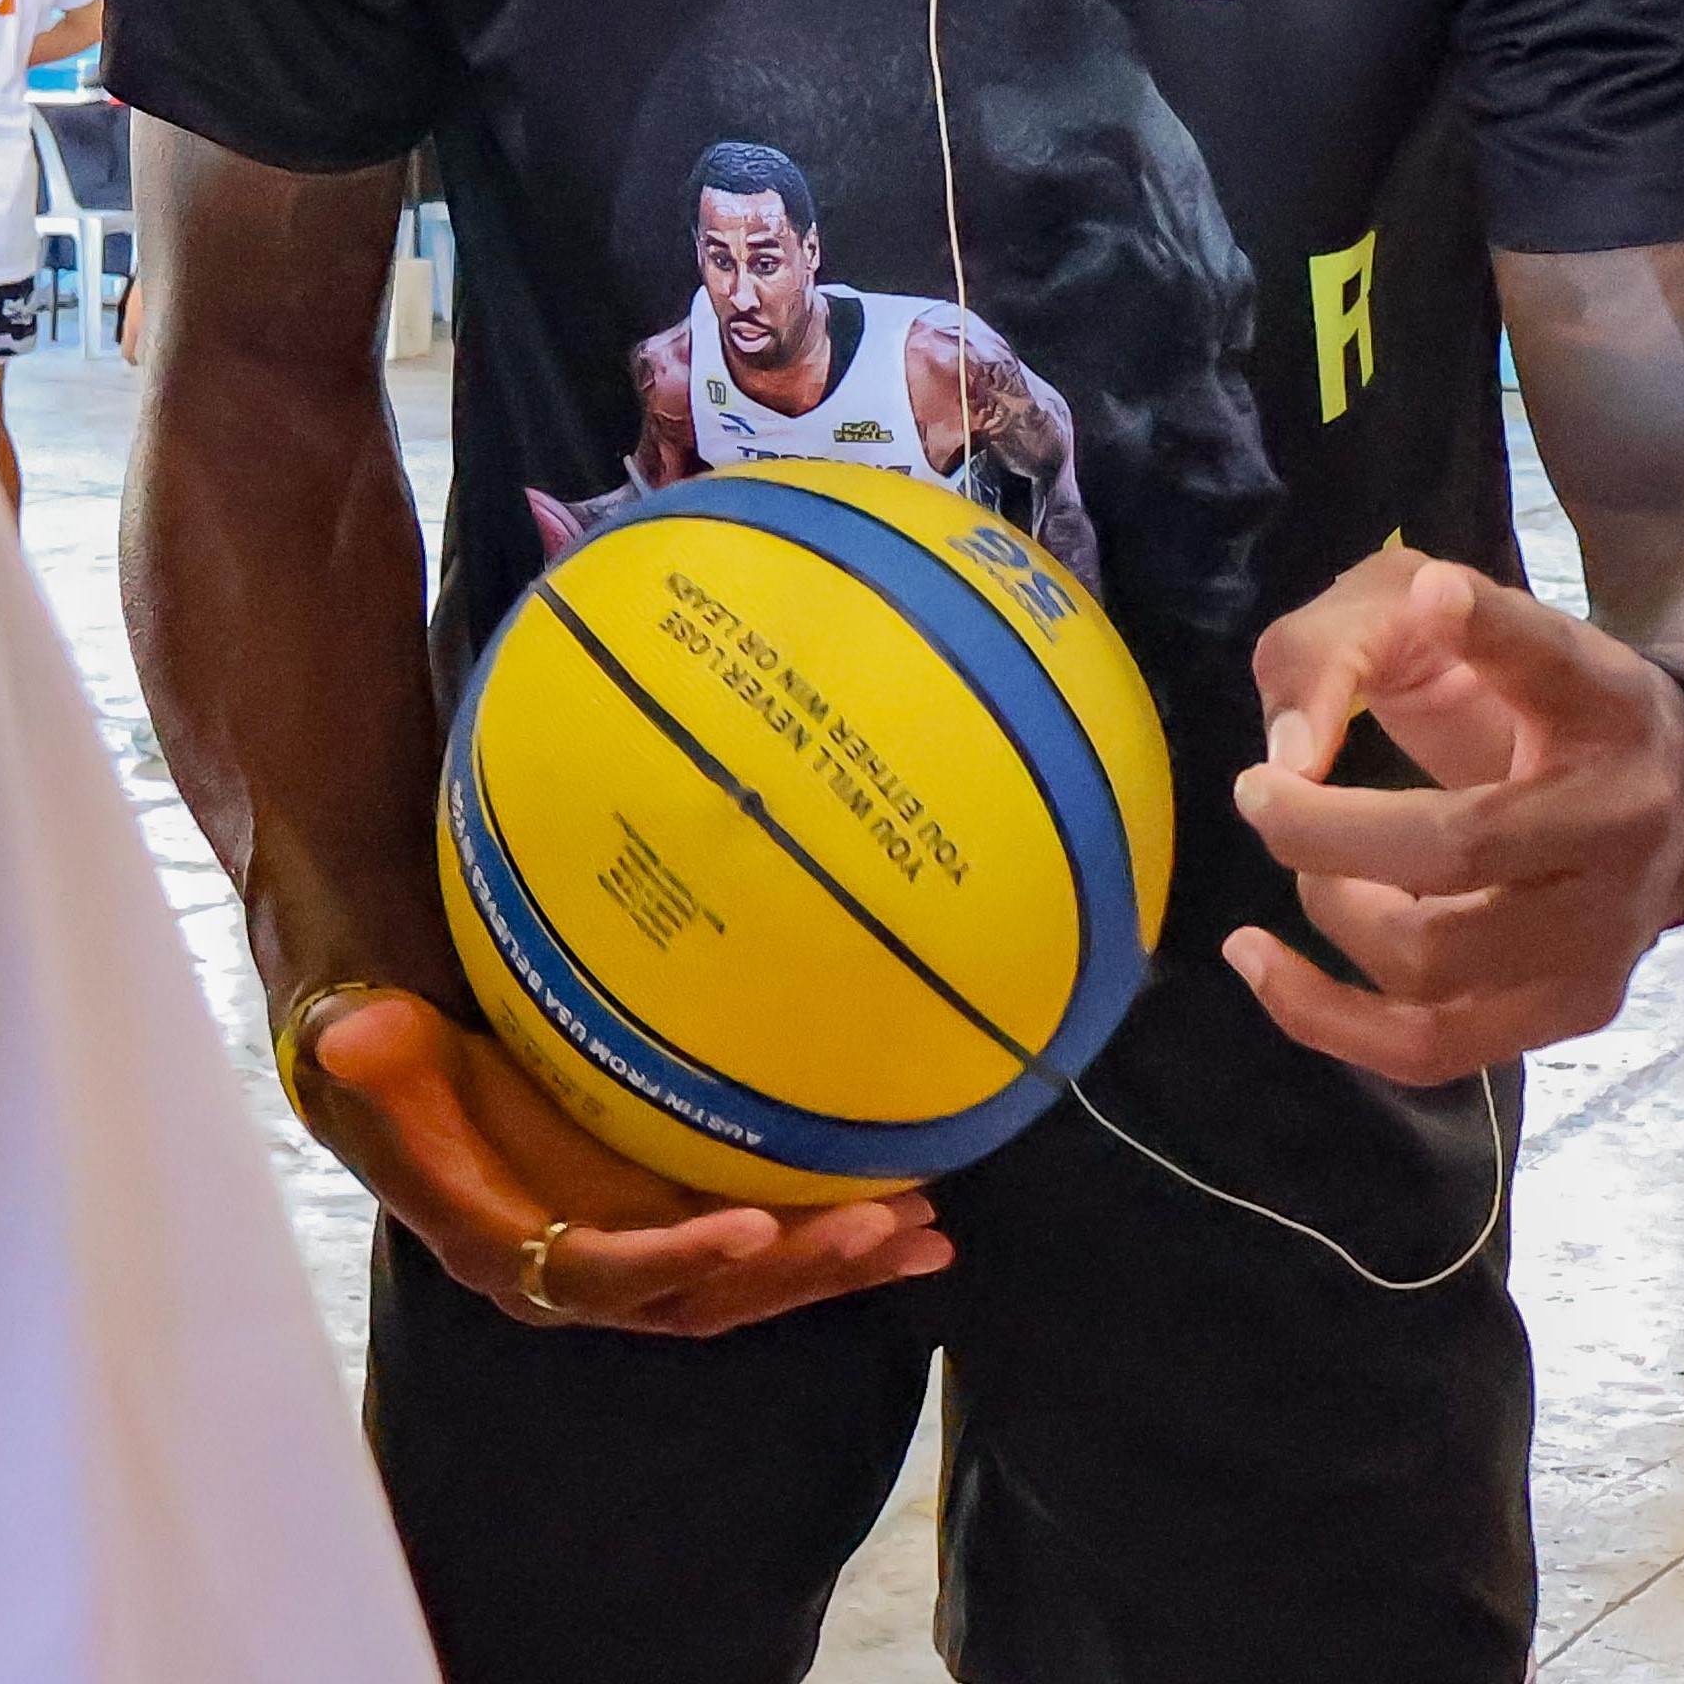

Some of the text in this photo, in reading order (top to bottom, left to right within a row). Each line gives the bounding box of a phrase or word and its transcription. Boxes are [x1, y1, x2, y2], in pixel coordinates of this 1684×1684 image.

[737, 630, 779, 672] OR
[775, 667, 829, 723] WIN
[657, 609, 923, 883] YOU WILL NEVER LOSE
[827, 716, 925, 825] EITHER
[918, 820, 970, 886] YOU
[546, 987, 587, 1043] USA
[589, 1038, 661, 1097] FROM
[665, 1092, 762, 1145] AUSTIN
